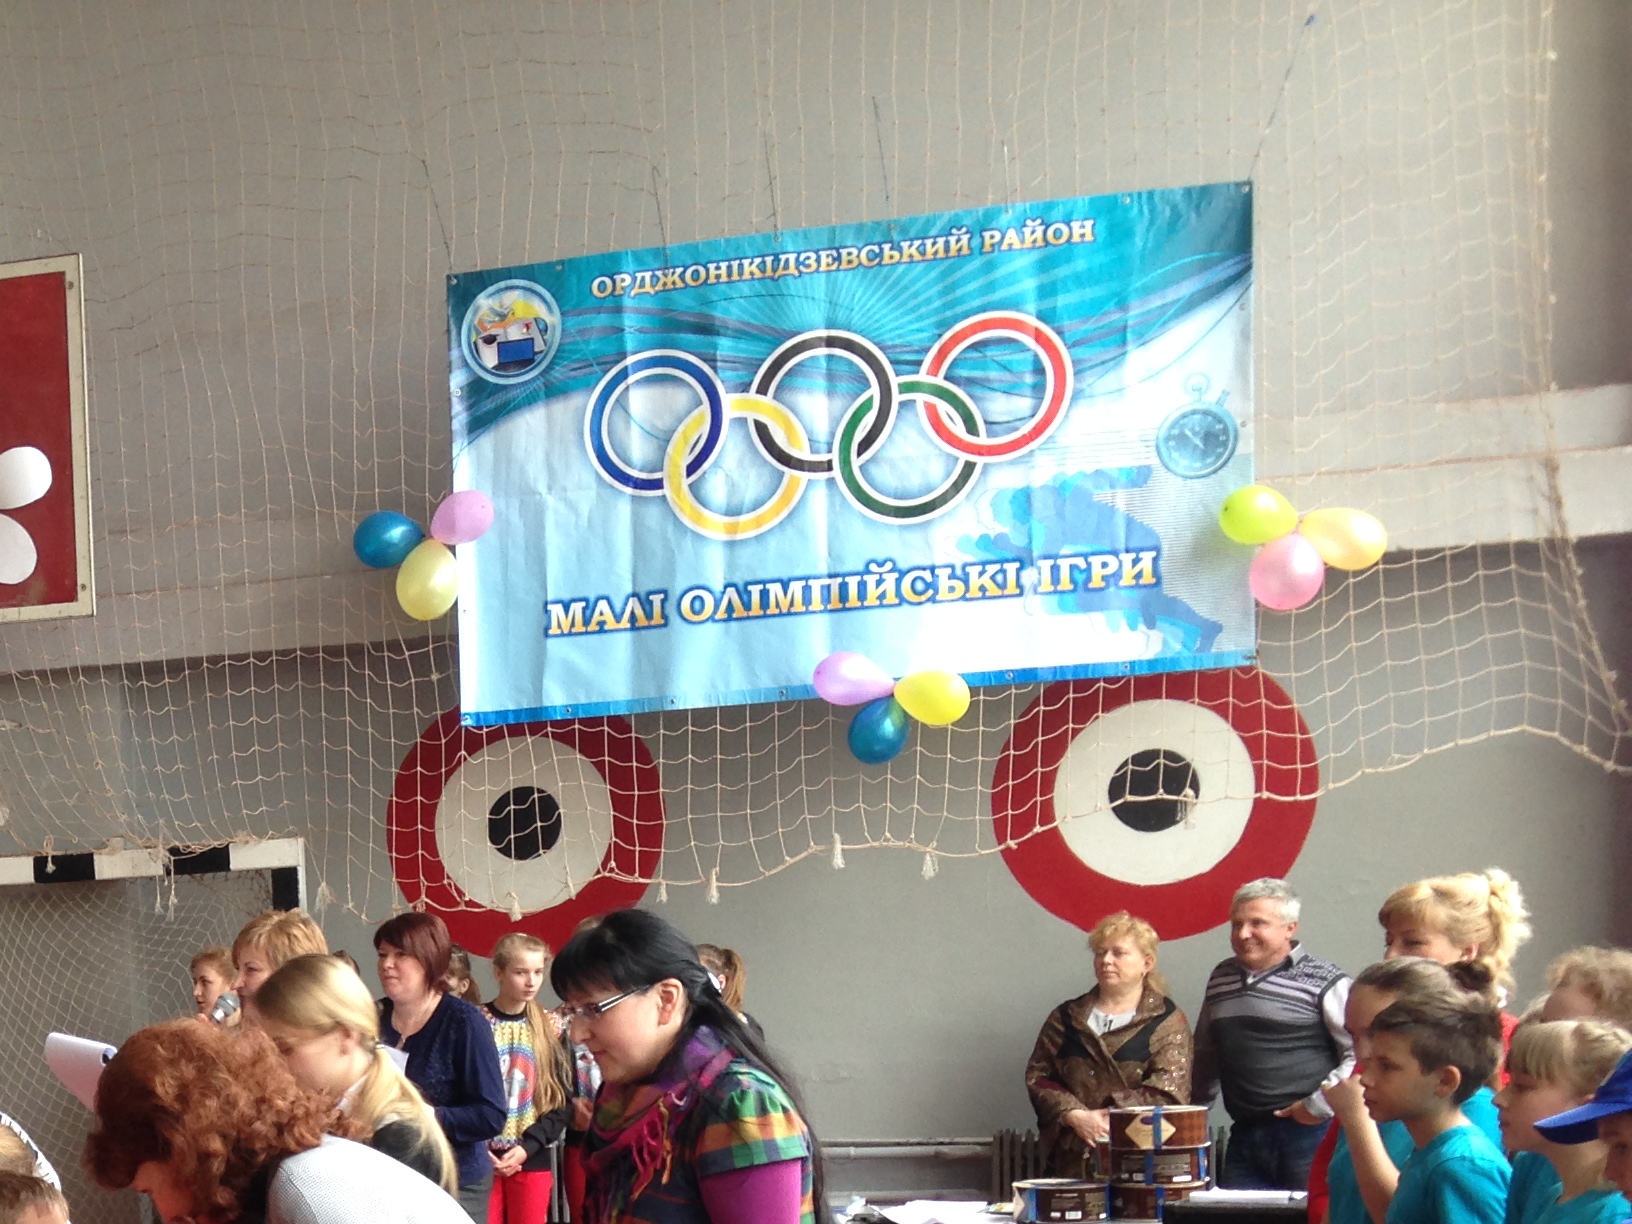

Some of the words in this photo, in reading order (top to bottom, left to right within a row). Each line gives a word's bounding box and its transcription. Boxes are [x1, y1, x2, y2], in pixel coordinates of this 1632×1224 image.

[591, 225, 973, 299] ОРДЖОНІКІДЗЕВСЬКИЙ
[980, 217, 1096, 267] РАЙОН
[545, 592, 666, 638] МАЛІ
[679, 555, 1020, 622] ОЛІМПІЙСЬКІ
[1036, 547, 1159, 597] ІГРИ
